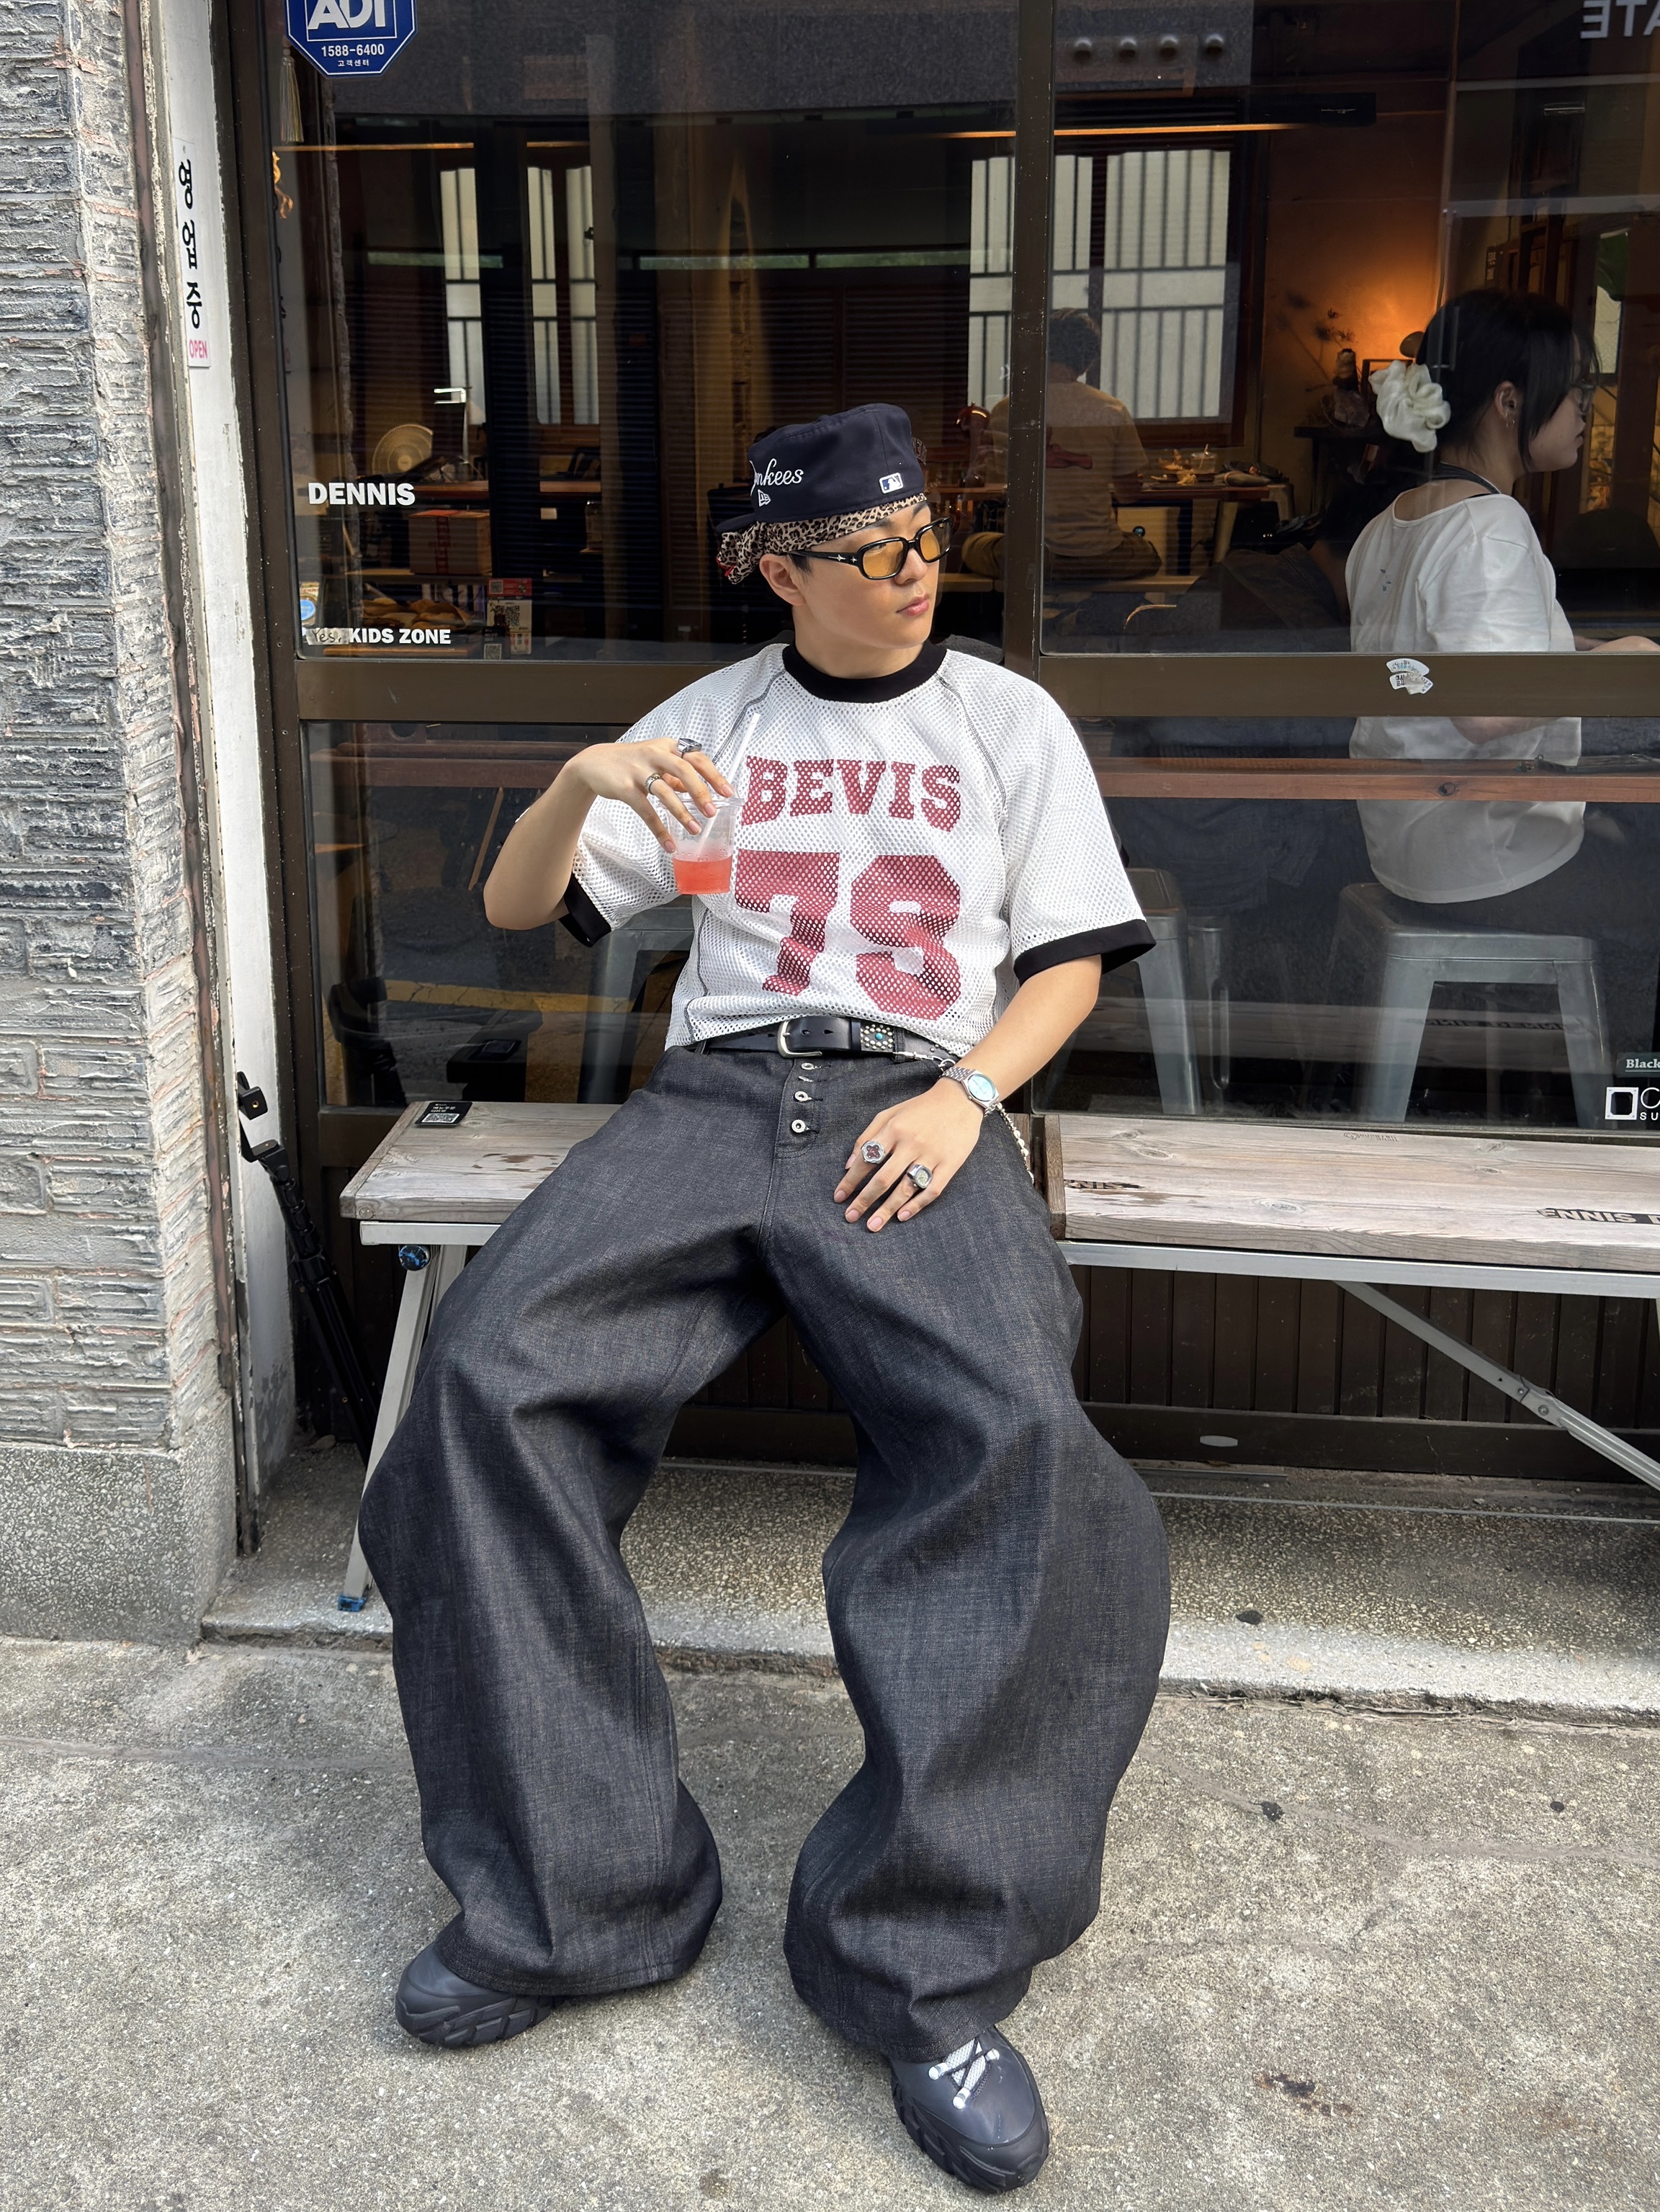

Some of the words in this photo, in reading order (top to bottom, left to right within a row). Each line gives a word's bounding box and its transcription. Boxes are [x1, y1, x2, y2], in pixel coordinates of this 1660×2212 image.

[321, 43, 385, 57] 1588-6400
[189, 340, 207, 359] OPEN
[308, 483, 416, 506] DENNIS
[349, 628, 394, 643] KIDS
[399, 629, 451, 644] ZONE
[741, 756, 961, 832] BEVIS
